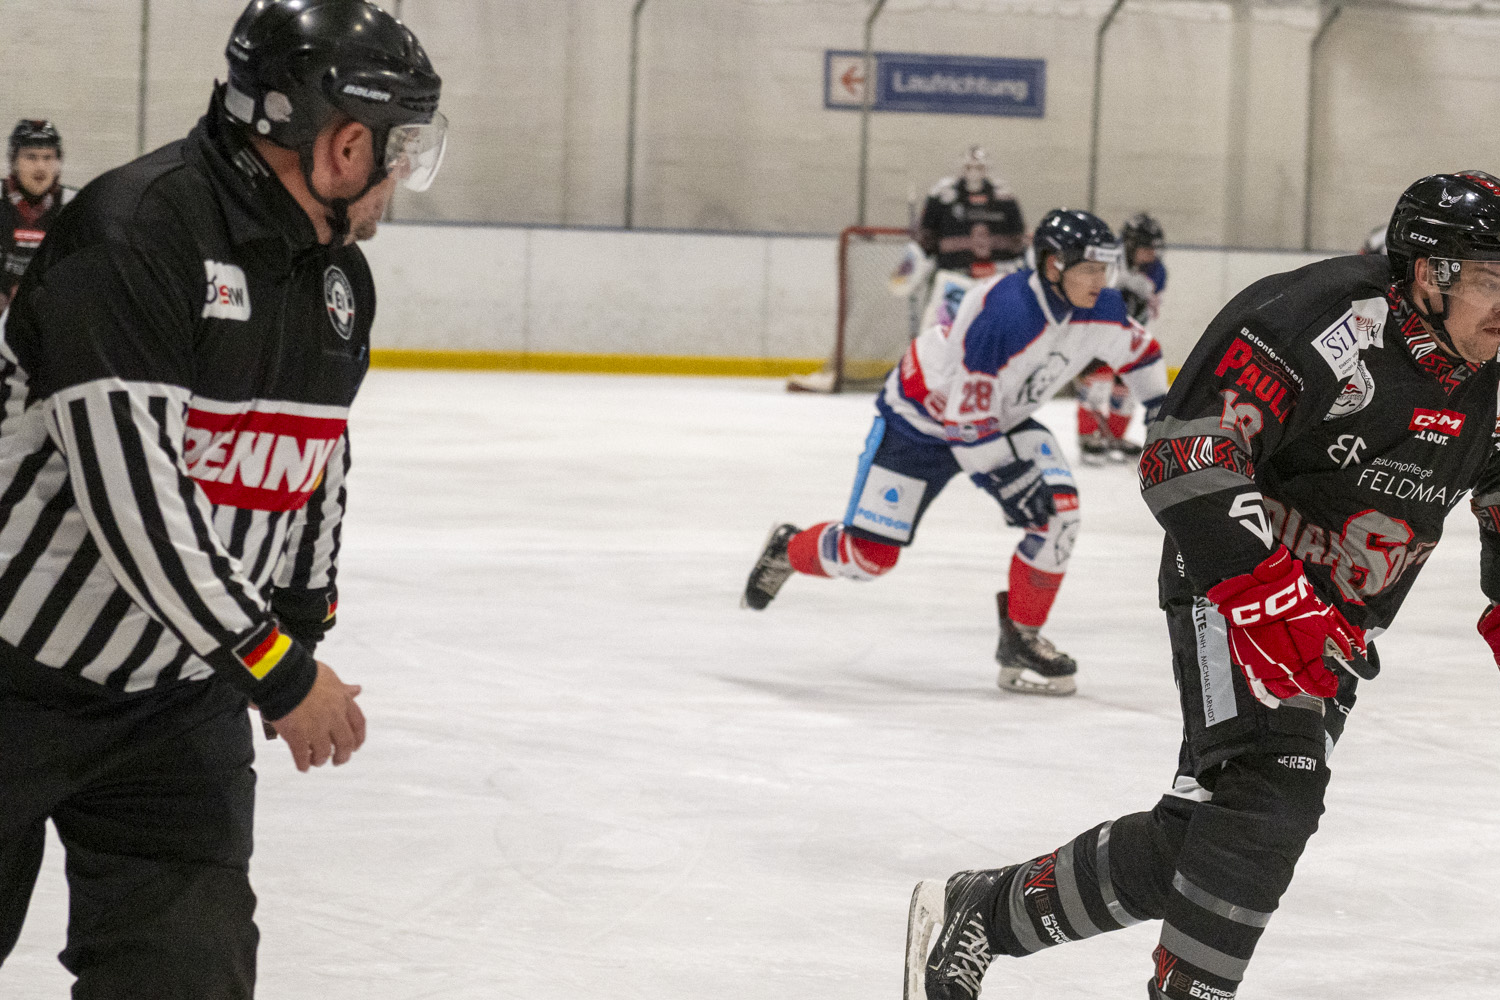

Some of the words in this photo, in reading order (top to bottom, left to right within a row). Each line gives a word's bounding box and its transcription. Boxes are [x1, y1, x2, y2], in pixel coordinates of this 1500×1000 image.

[891, 70, 1029, 102] Laufrichtung
[1409, 230, 1439, 246] CCM
[957, 379, 994, 417] 28
[184, 426, 335, 493] PENNY
[1371, 456, 1434, 480] Baumpflege
[1200, 655, 1211, 695] MICHAEL
[1205, 694, 1216, 723] ARNDT
